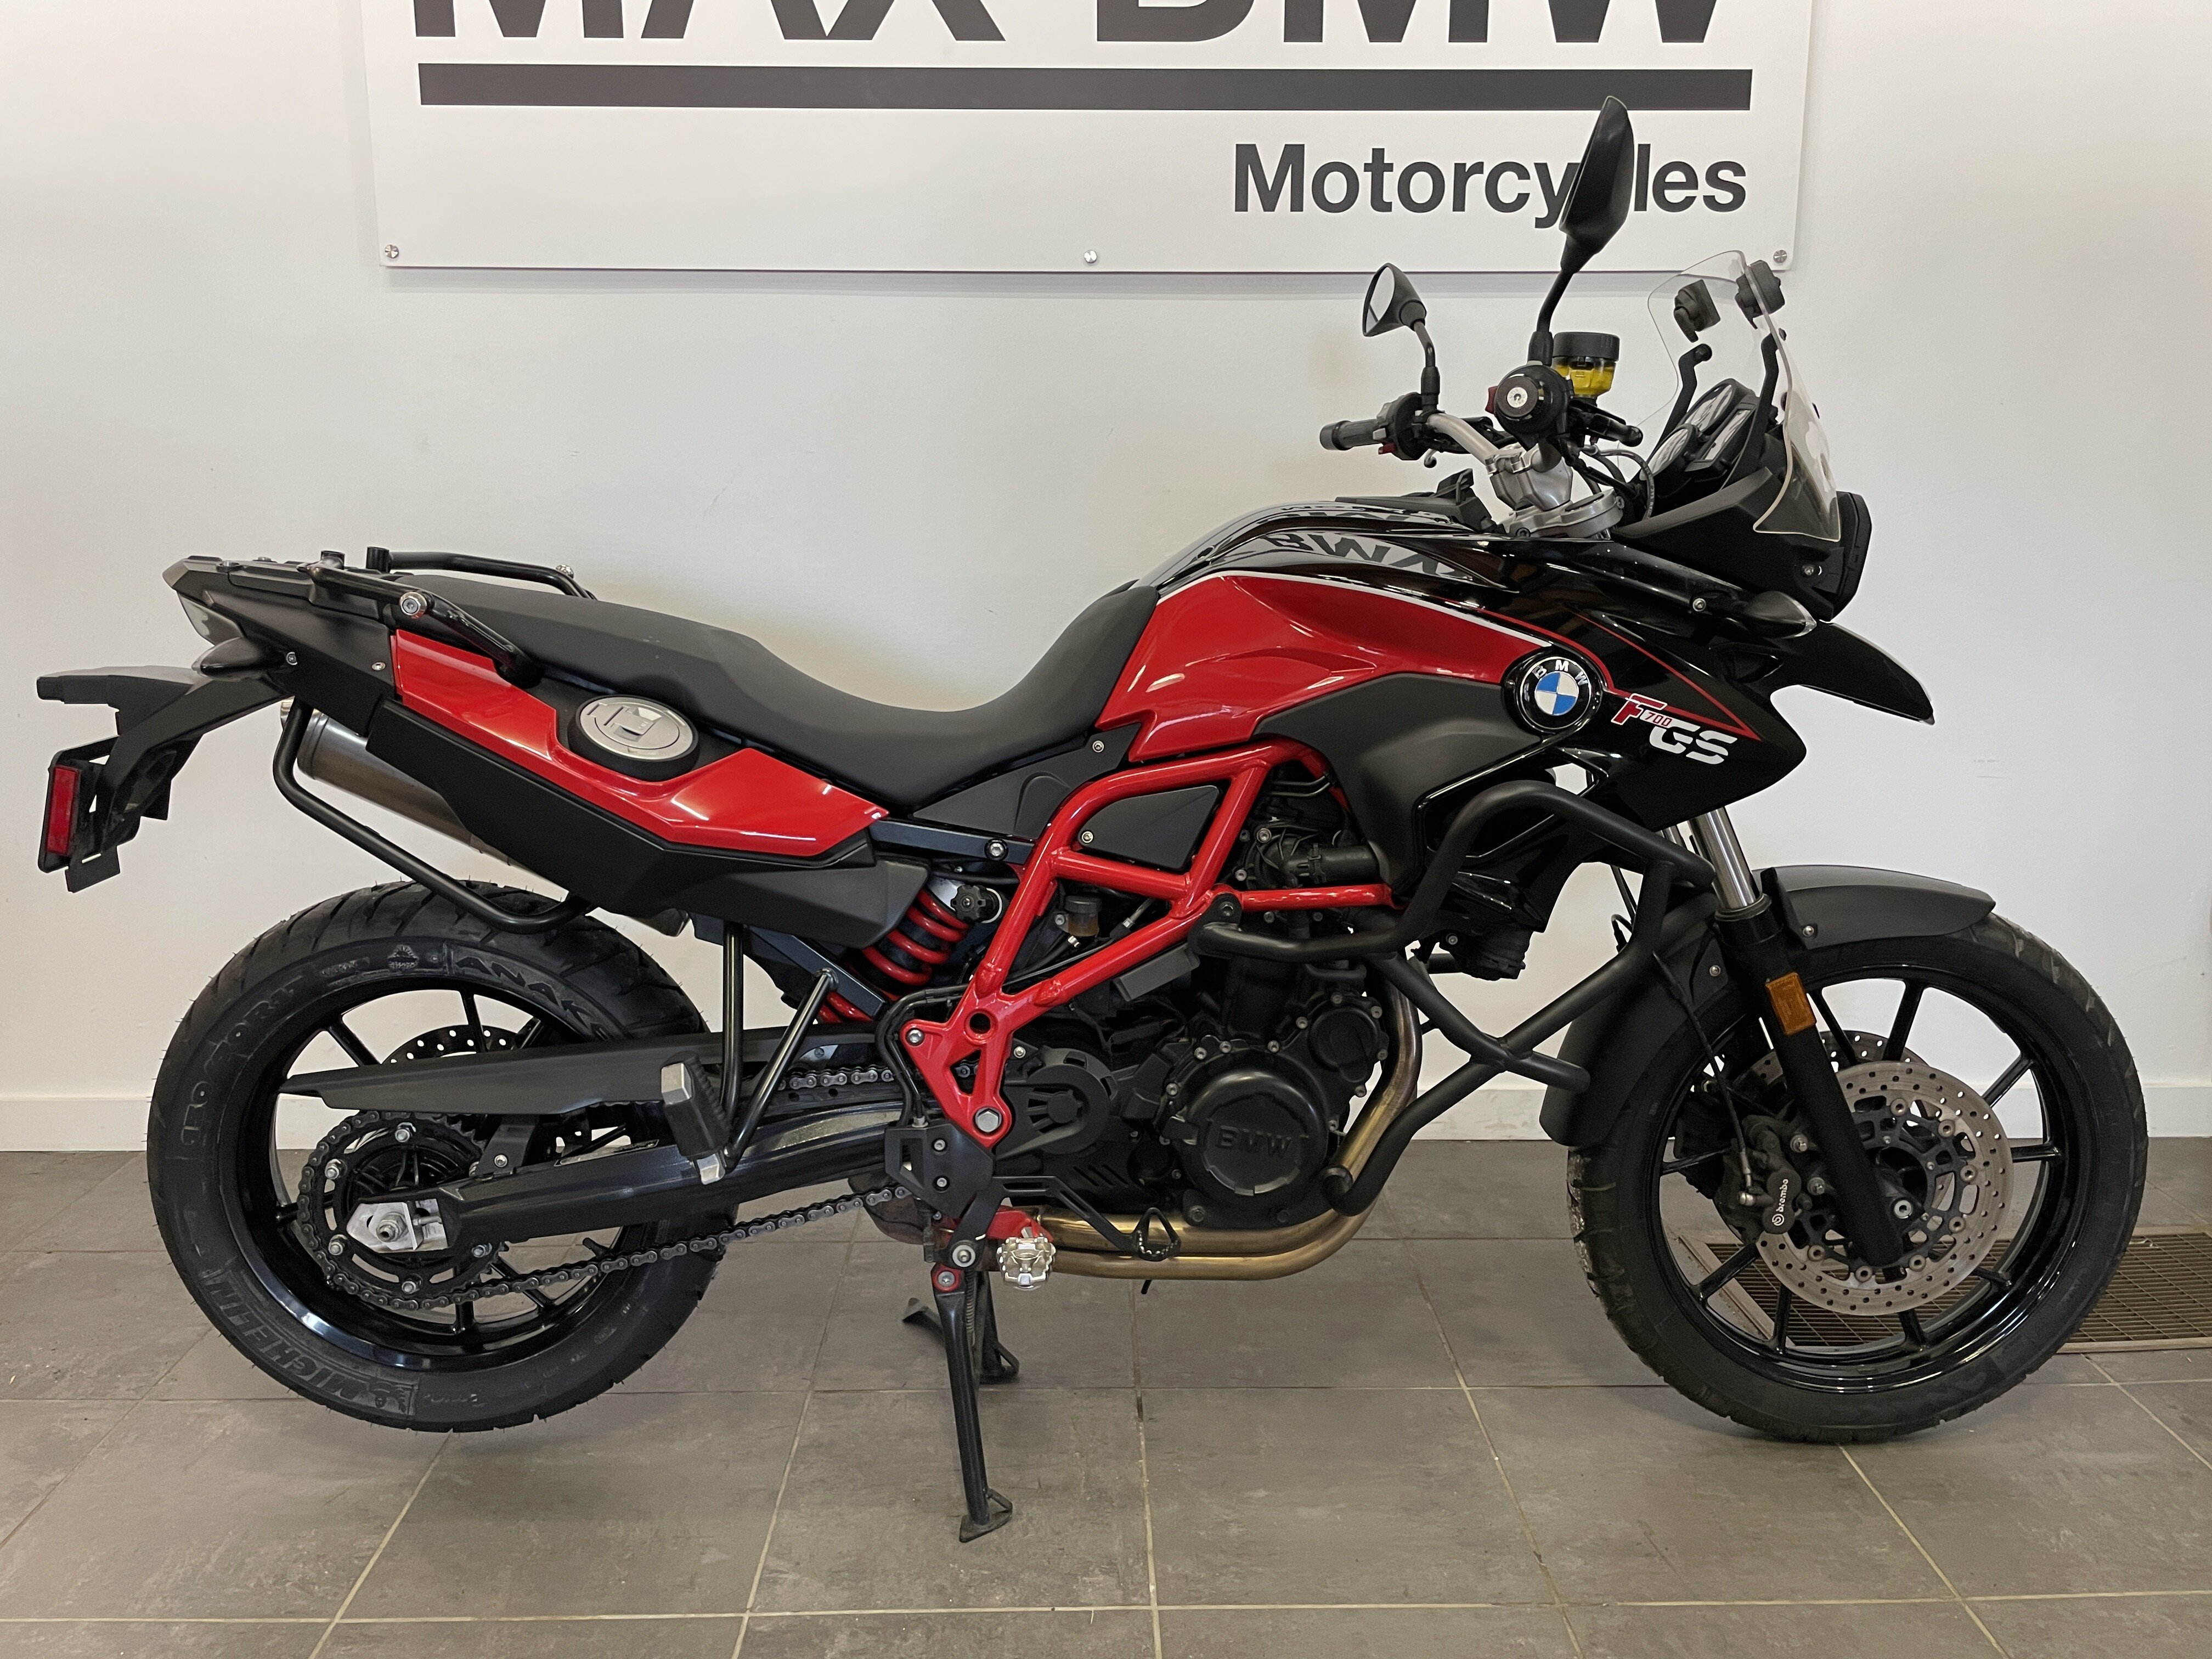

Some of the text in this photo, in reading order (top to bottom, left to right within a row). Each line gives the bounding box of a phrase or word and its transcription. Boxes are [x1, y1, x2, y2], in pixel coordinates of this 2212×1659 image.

[1235, 143, 1747, 229] Motorcyles
[1533, 659, 1589, 686] BMW
[1611, 693, 1737, 765] F 700 GS
[1218, 1124, 1293, 1156] BMW
[1775, 1178, 1789, 1212] brembo
[203, 1274, 371, 1402] MICHELIN
